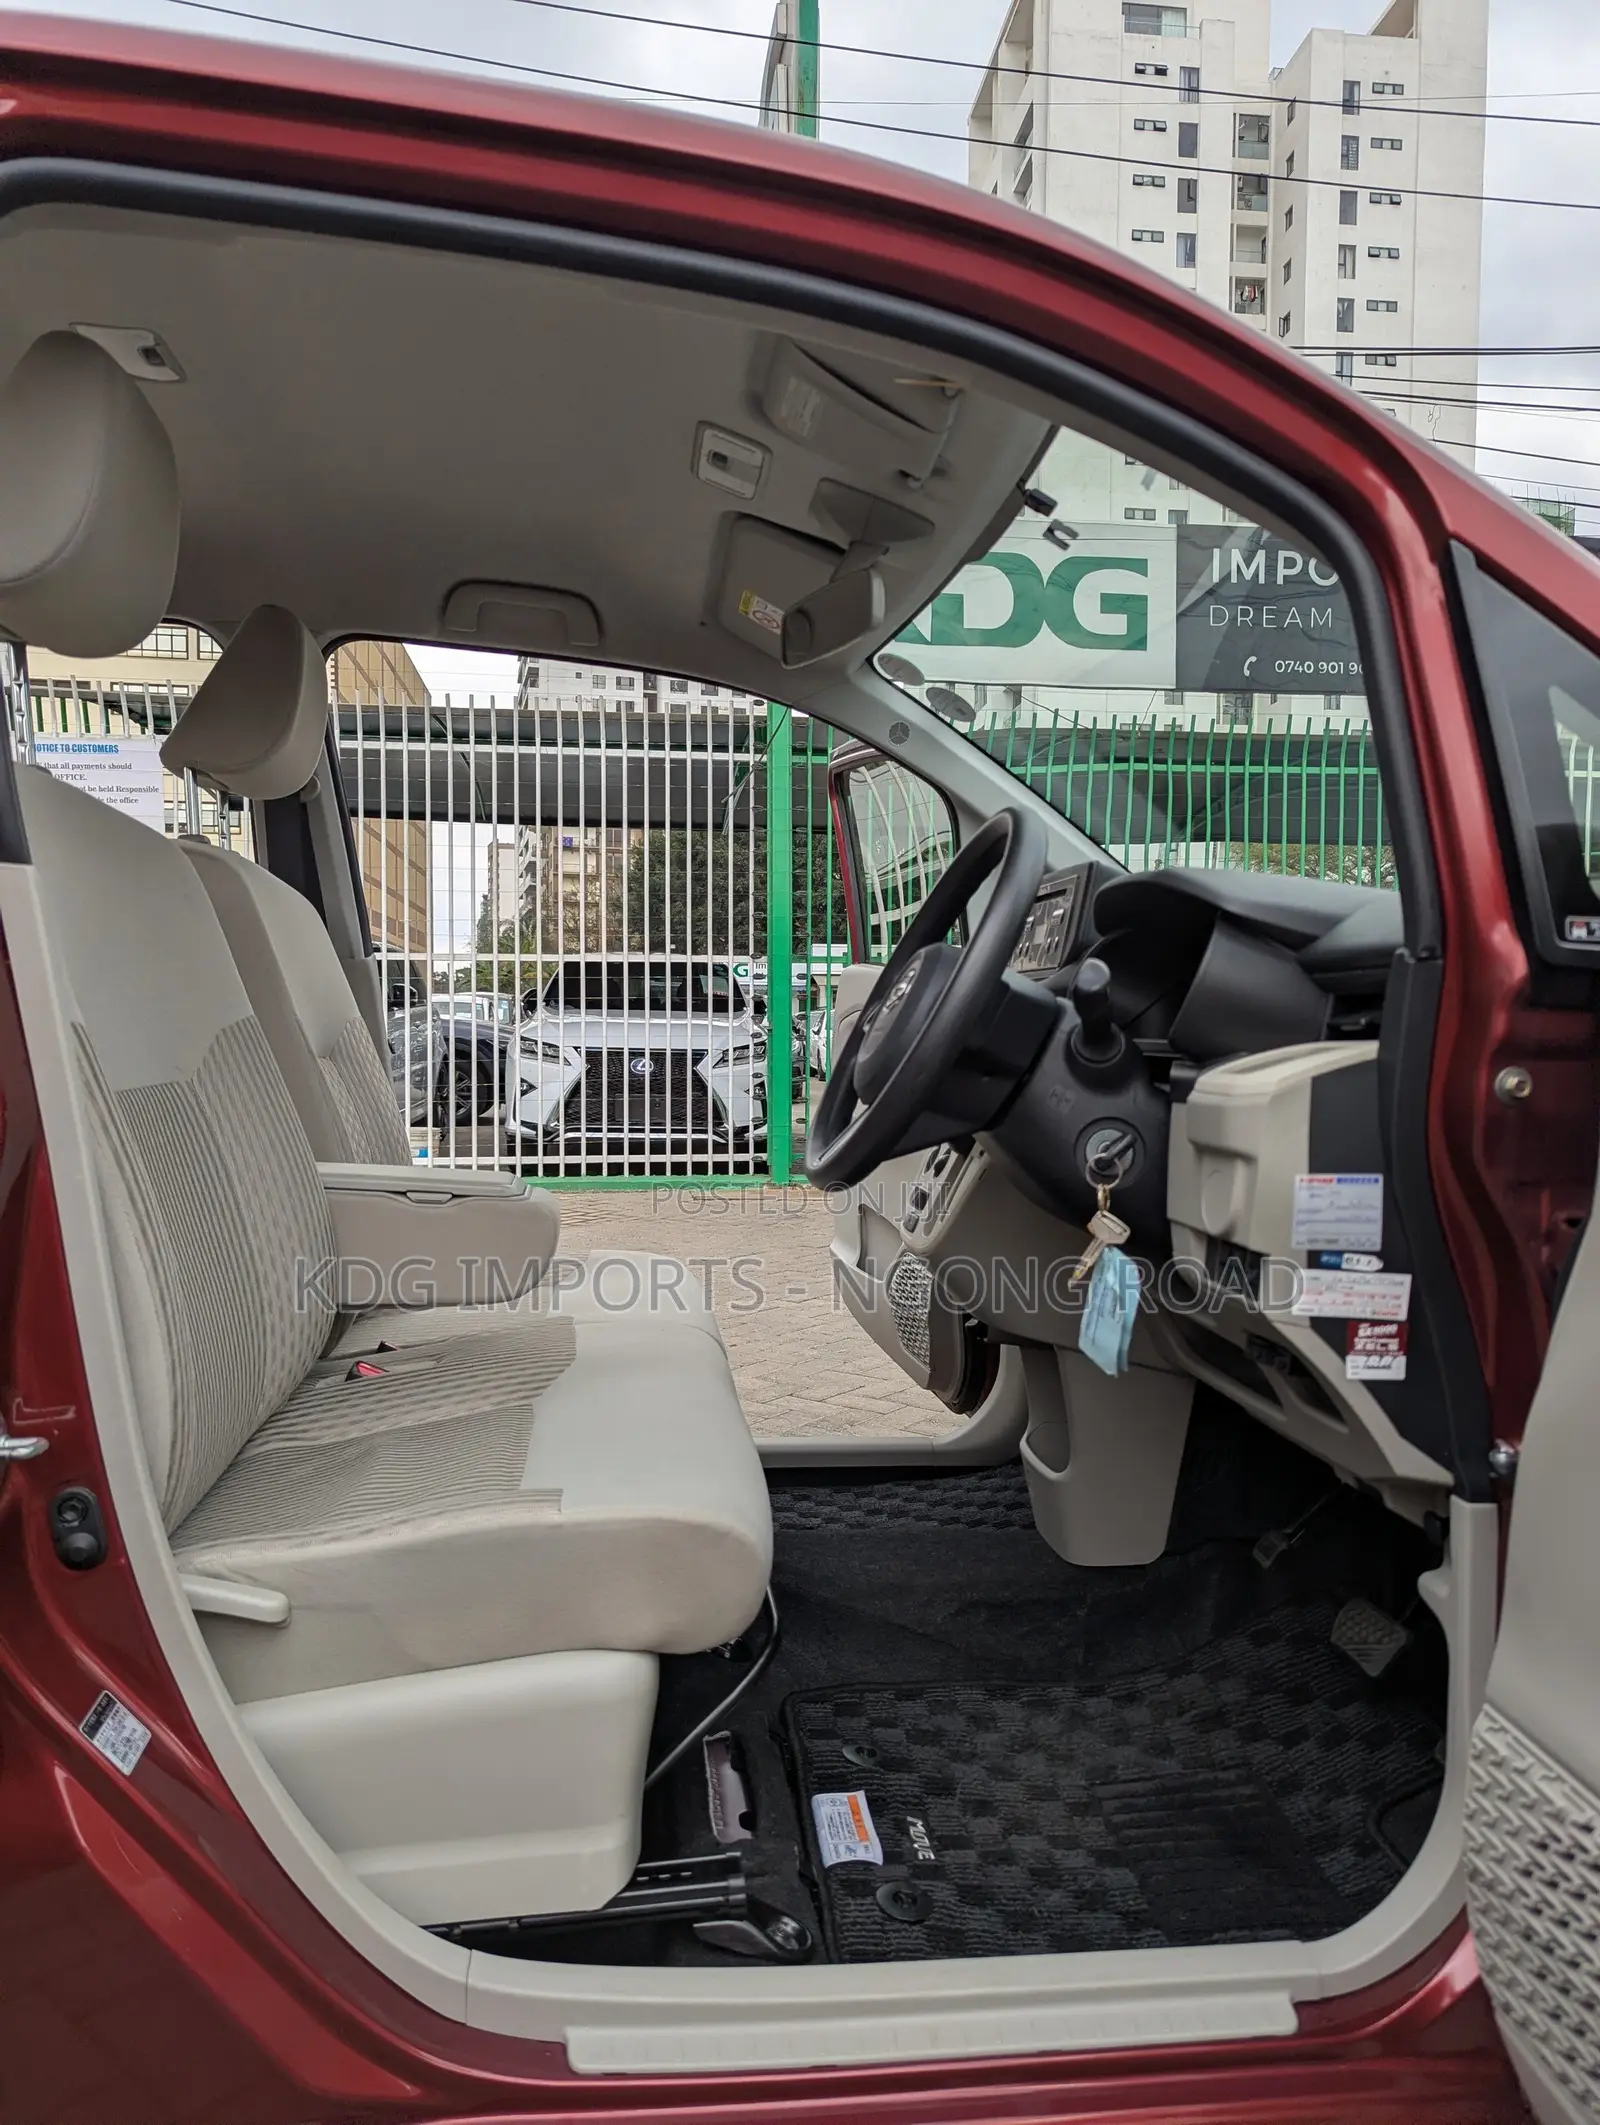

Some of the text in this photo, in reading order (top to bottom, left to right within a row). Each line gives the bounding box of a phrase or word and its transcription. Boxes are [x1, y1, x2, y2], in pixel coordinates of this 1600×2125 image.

[1209, 605, 1332, 629] DREAM
[1274, 660, 1314, 674] 0740
[1318, 662, 1344, 674] 901
[60, 743, 70, 753] TO
[71, 744, 119, 754] CUSTOMERS
[71, 763, 107, 772] payments
[116, 786, 160, 795] Responsible
